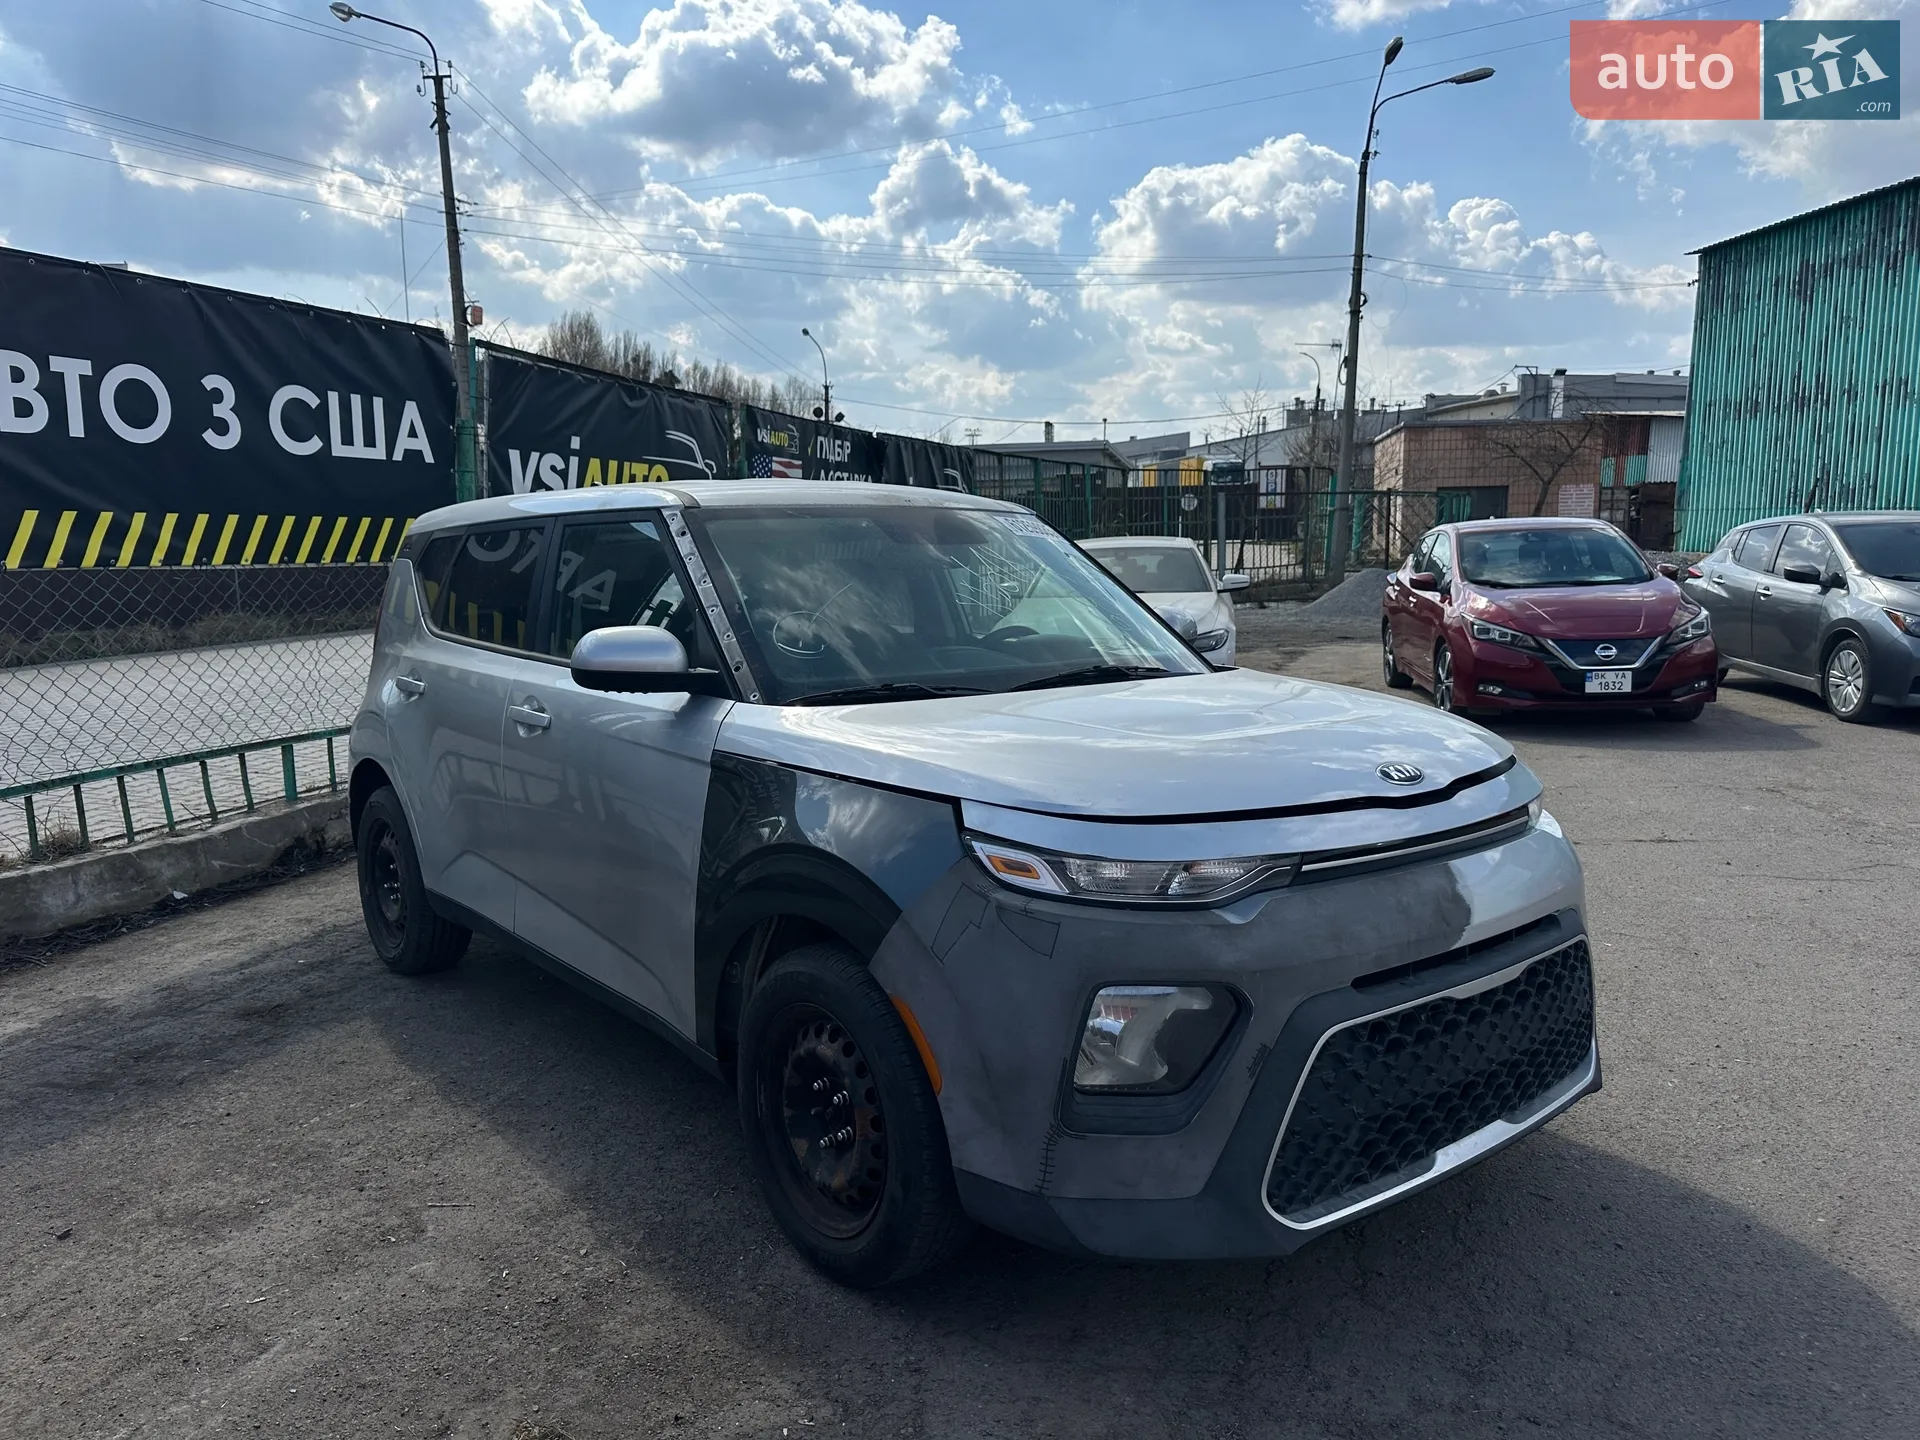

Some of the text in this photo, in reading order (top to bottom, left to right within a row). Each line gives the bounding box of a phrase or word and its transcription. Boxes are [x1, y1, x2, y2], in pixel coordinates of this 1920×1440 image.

[268, 384, 435, 464] США
[1614, 672, 1627, 680] YA
[1598, 681, 1624, 691] 1832
